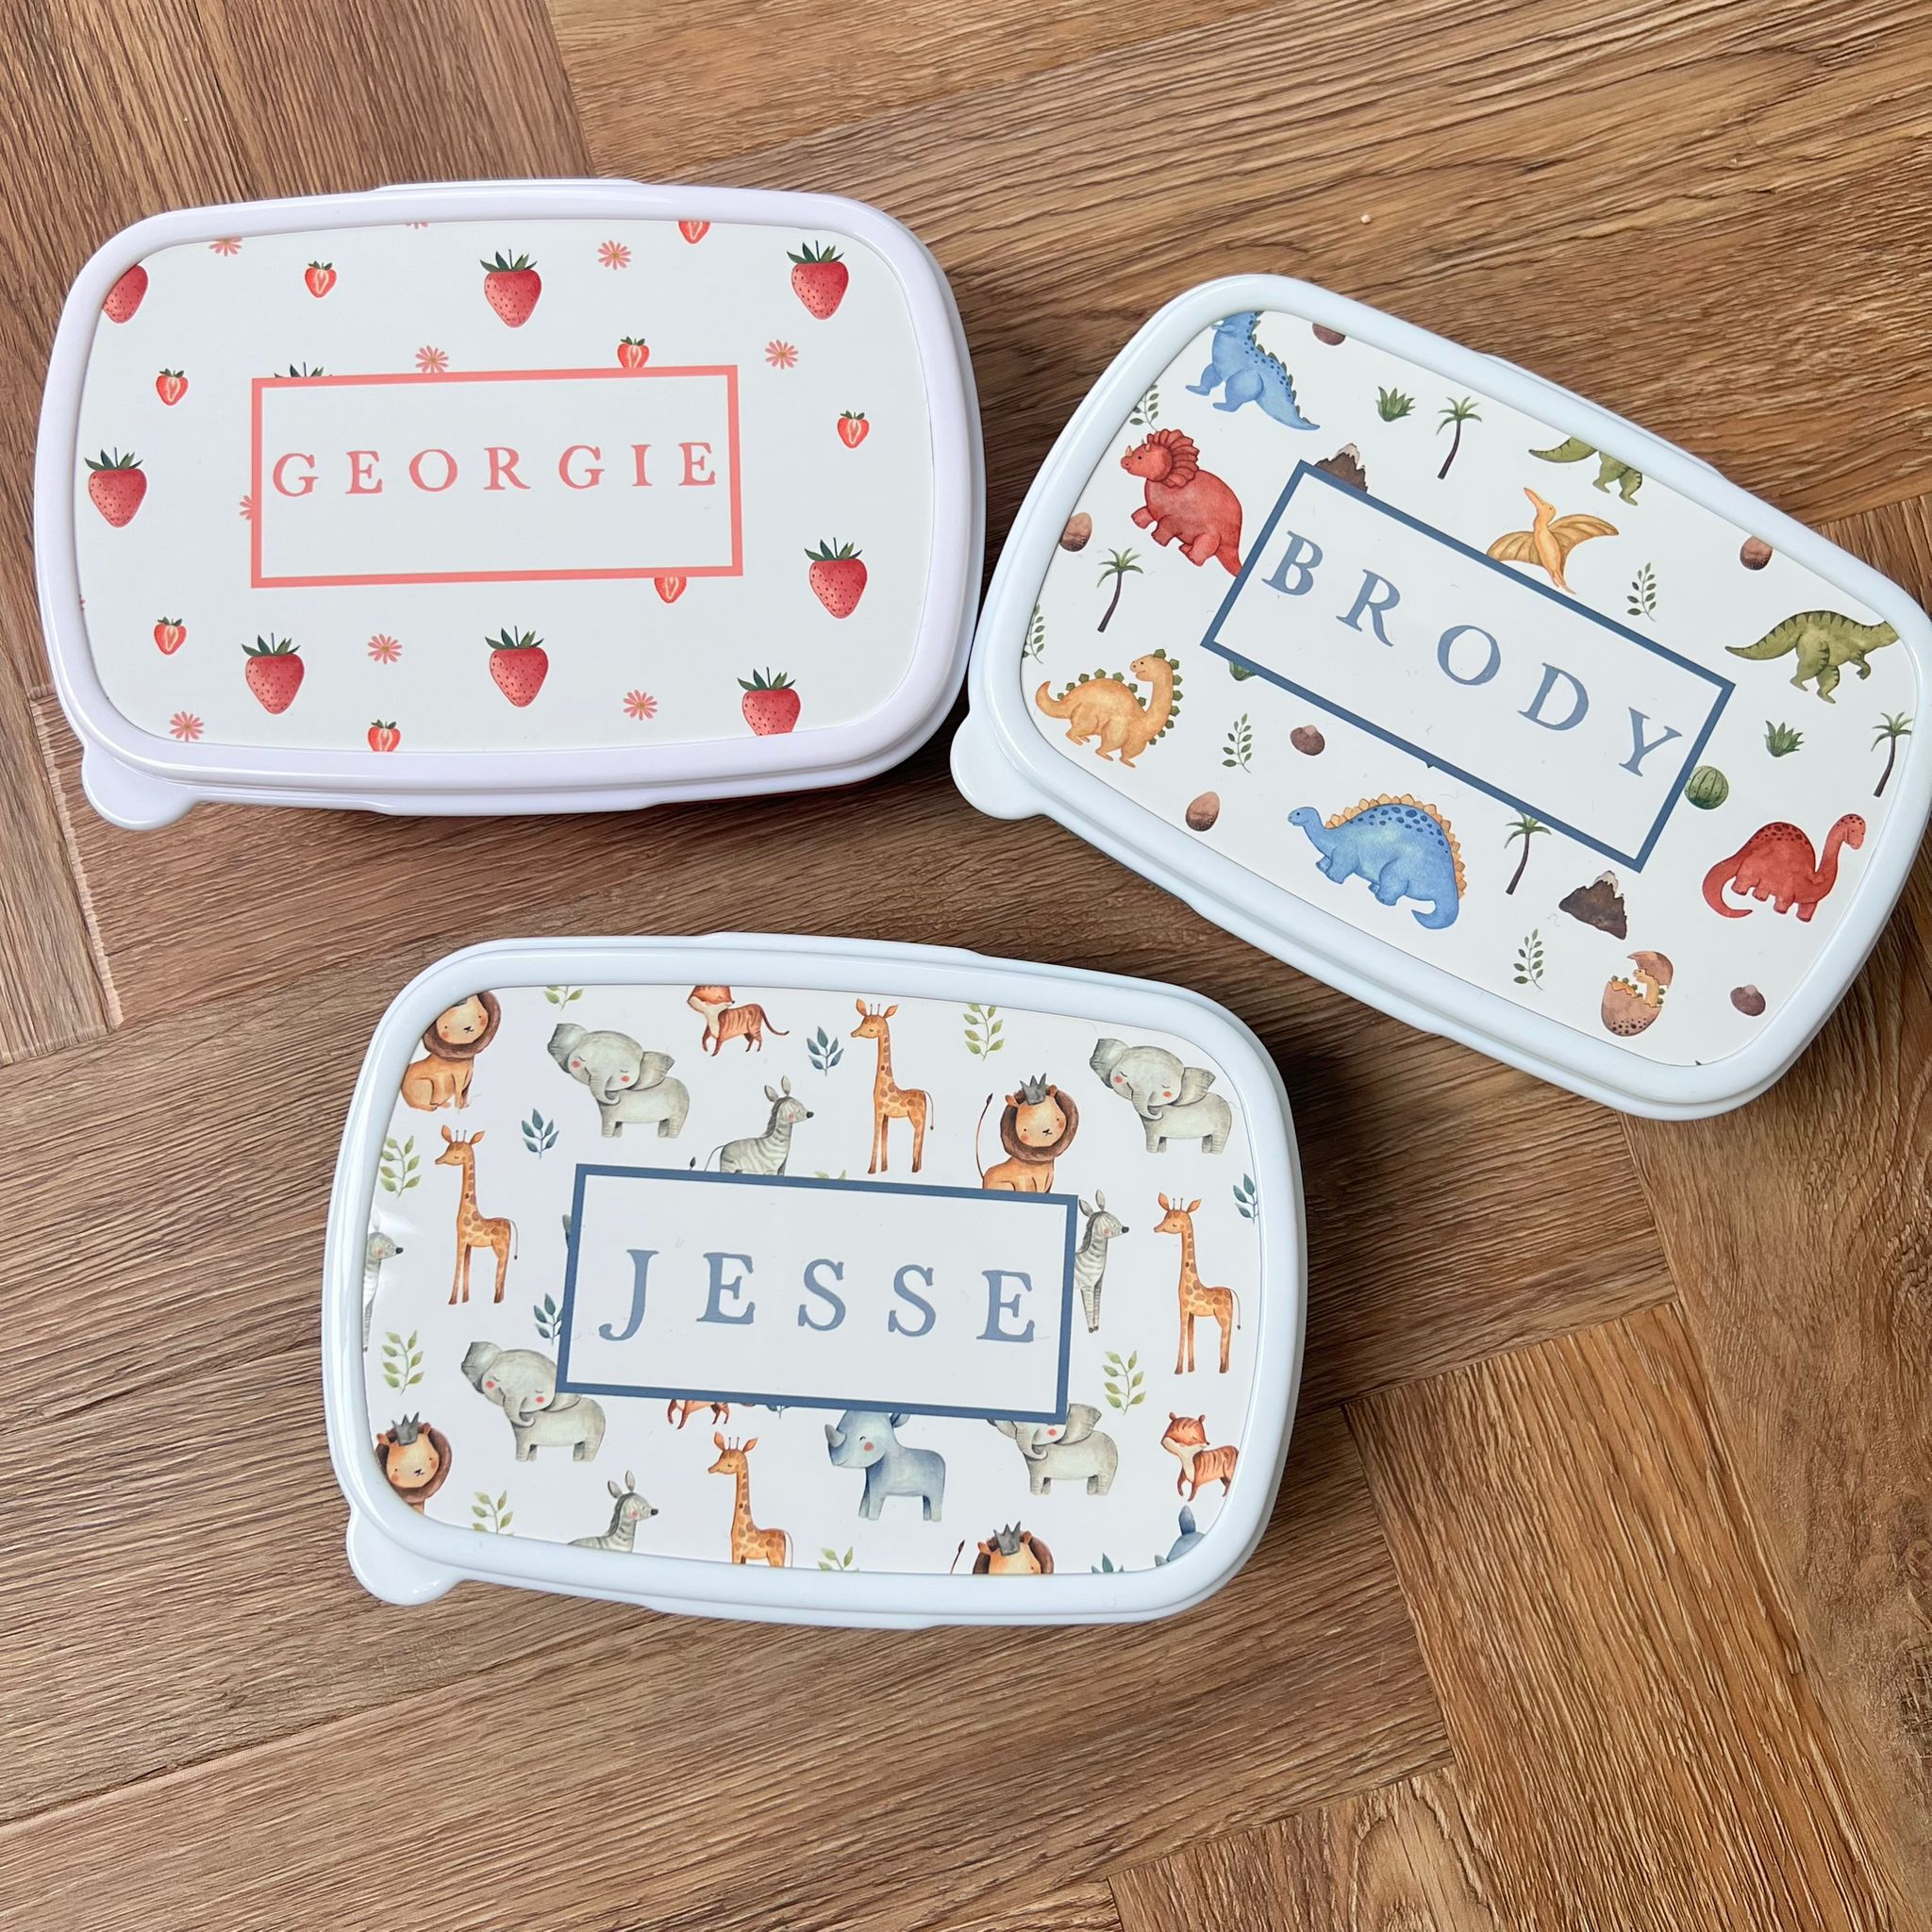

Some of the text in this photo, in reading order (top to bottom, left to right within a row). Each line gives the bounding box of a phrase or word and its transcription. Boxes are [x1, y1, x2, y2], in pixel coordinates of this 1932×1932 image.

[272, 441, 717, 498] GEORGIE
[1260, 529, 1684, 778] BRODY
[597, 1248, 1037, 1343] JESSE
